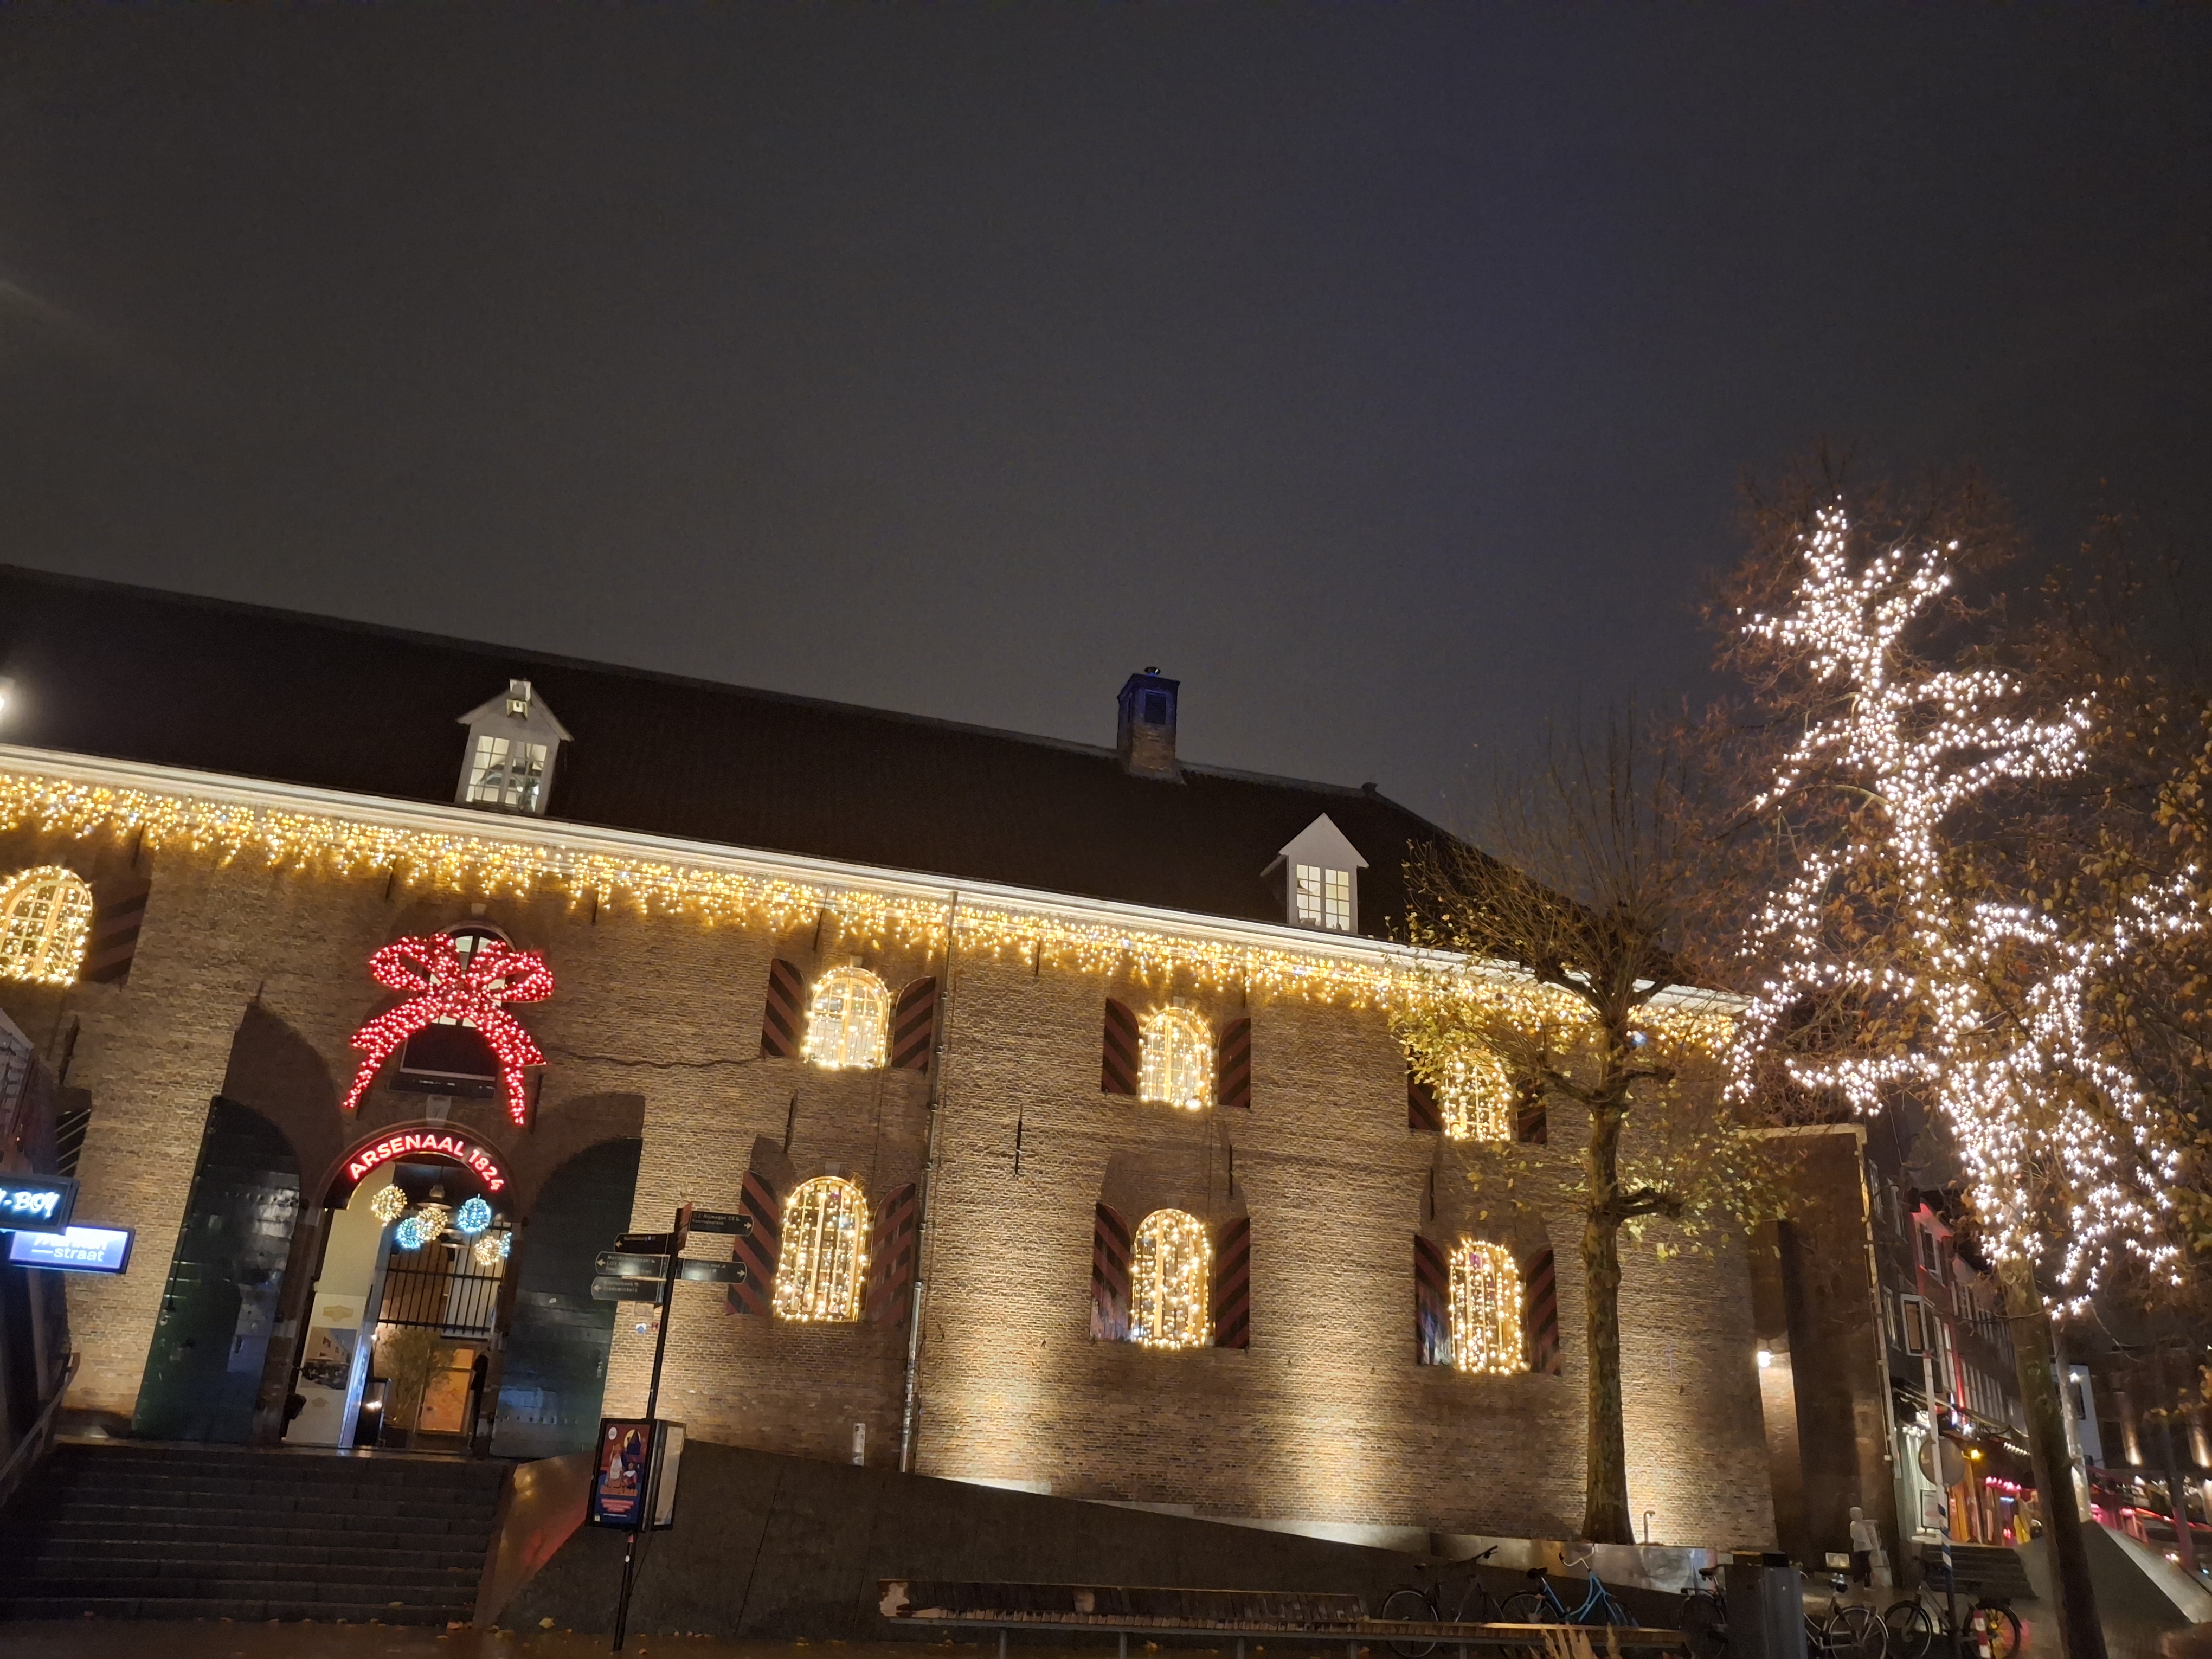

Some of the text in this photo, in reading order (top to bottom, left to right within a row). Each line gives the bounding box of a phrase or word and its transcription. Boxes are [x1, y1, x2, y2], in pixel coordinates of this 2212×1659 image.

[350, 1134, 504, 1191] ARSENAAL 1824
[54, 1247, 104, 1262] straat
